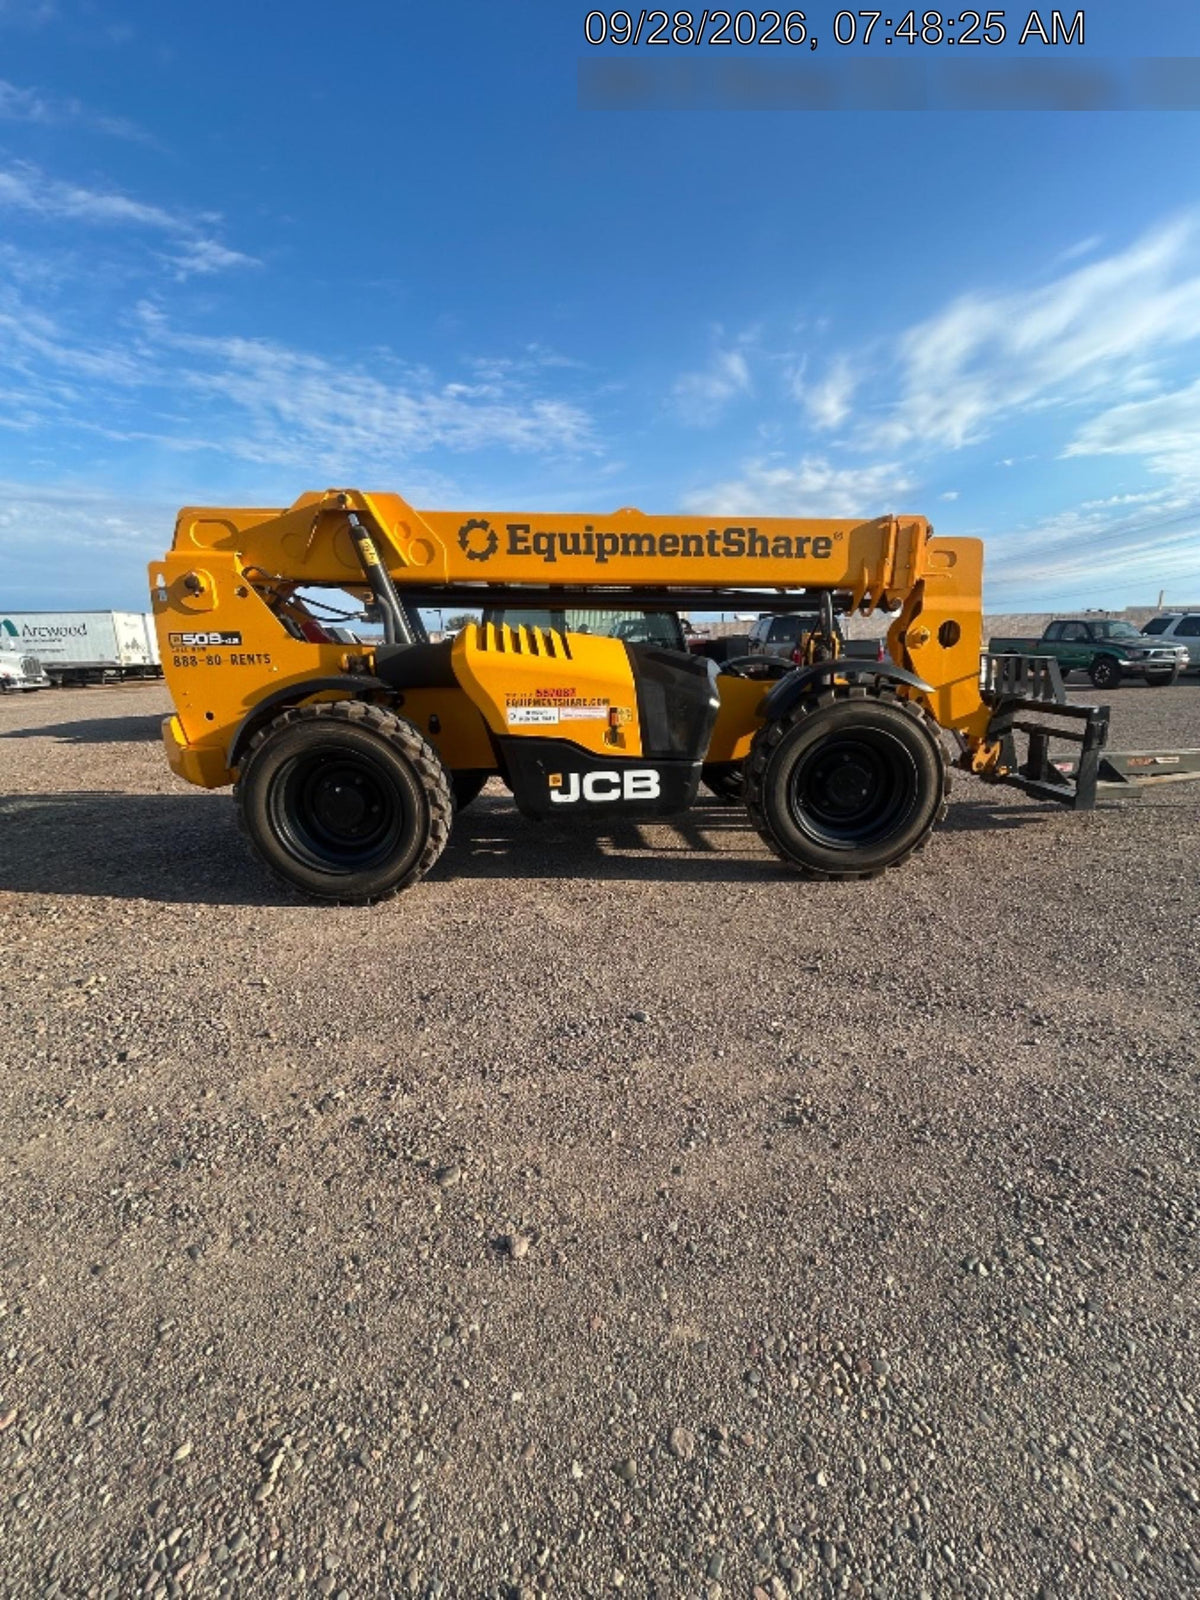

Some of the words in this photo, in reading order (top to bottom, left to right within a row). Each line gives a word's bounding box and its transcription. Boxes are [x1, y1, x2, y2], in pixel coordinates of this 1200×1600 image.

[506, 523, 833, 562] EquipmentShare
[22, 622, 88, 638] Arcwood
[549, 768, 661, 803] JCB
